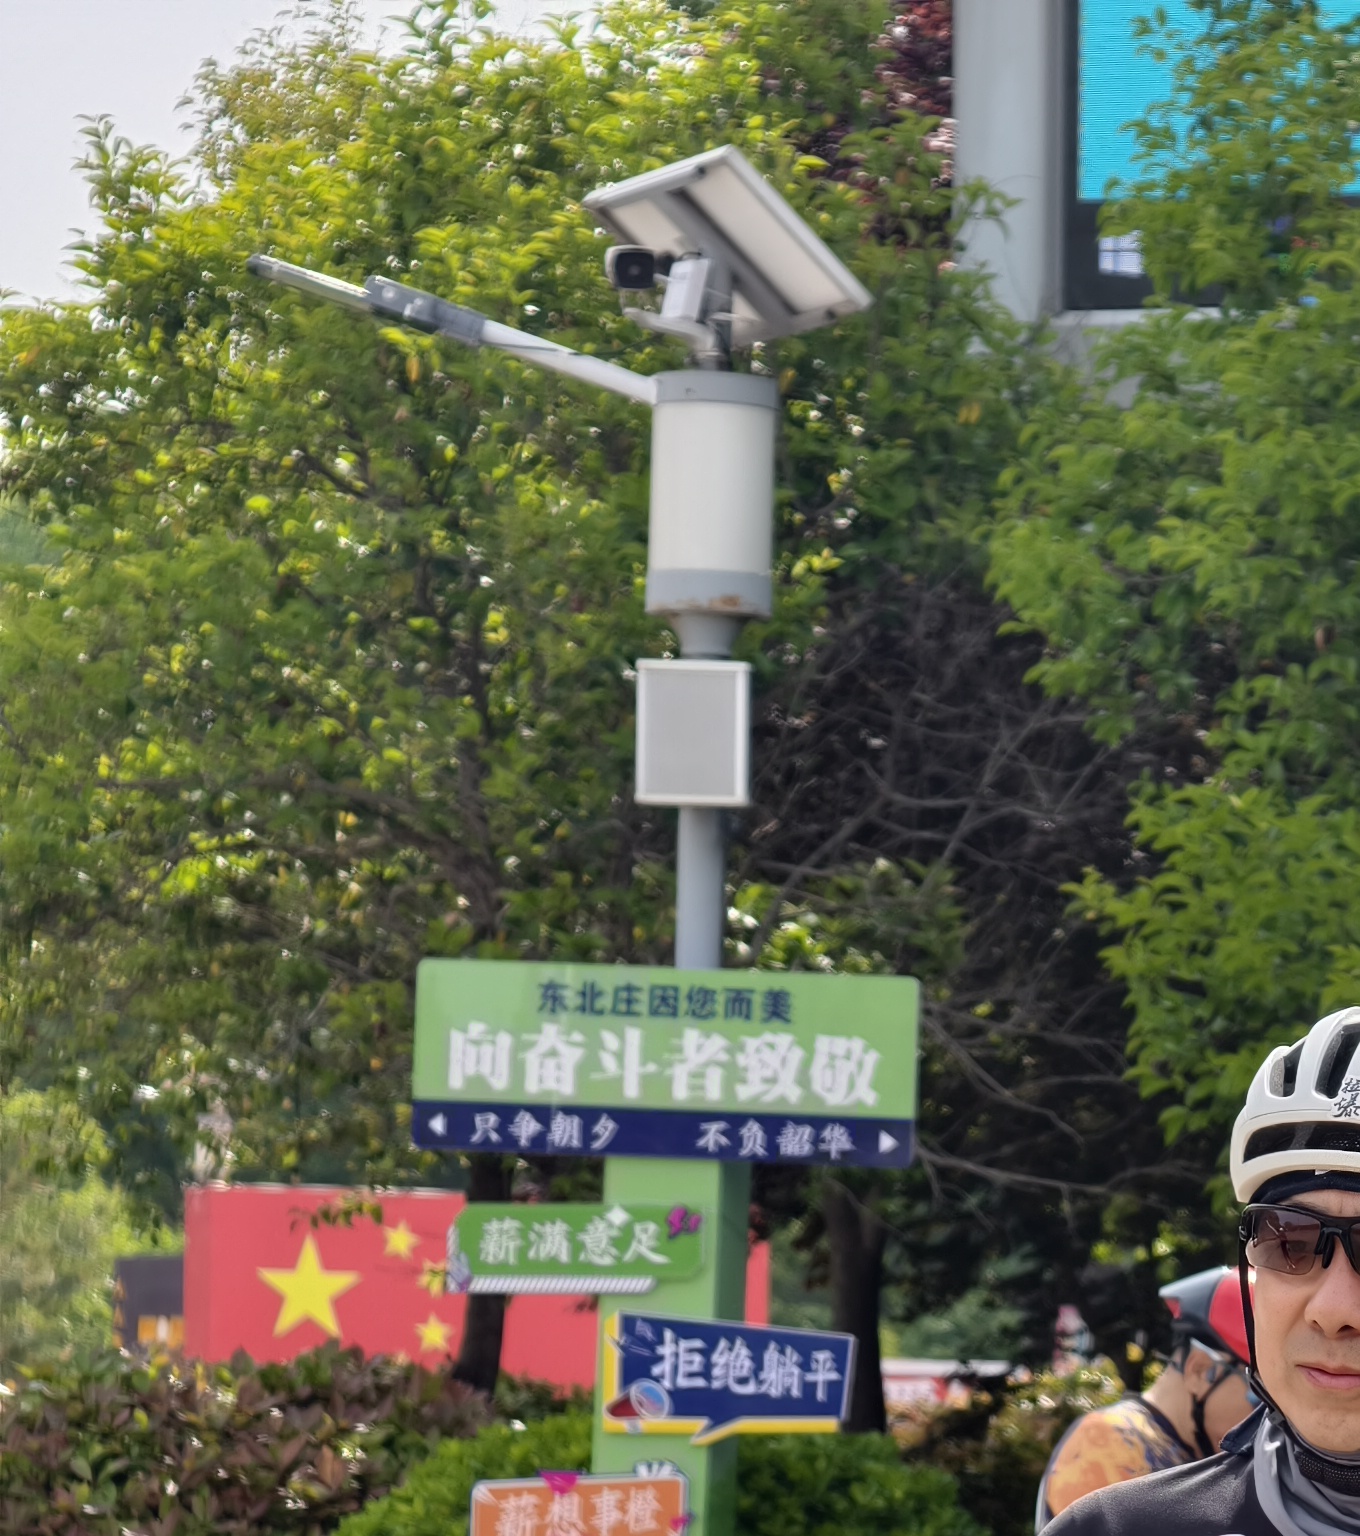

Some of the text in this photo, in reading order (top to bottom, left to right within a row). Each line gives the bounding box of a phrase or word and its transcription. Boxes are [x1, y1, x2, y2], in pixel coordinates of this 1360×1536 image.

[537, 979, 795, 1025] 东北庄因您而美
[446, 1020, 882, 1107] 向奋斗者致敬
[469, 1109, 856, 1161] 只争朝夕 不负韶华
[478, 1214, 672, 1267] 薪满意足
[650, 1327, 843, 1403] 拒绝躺平
